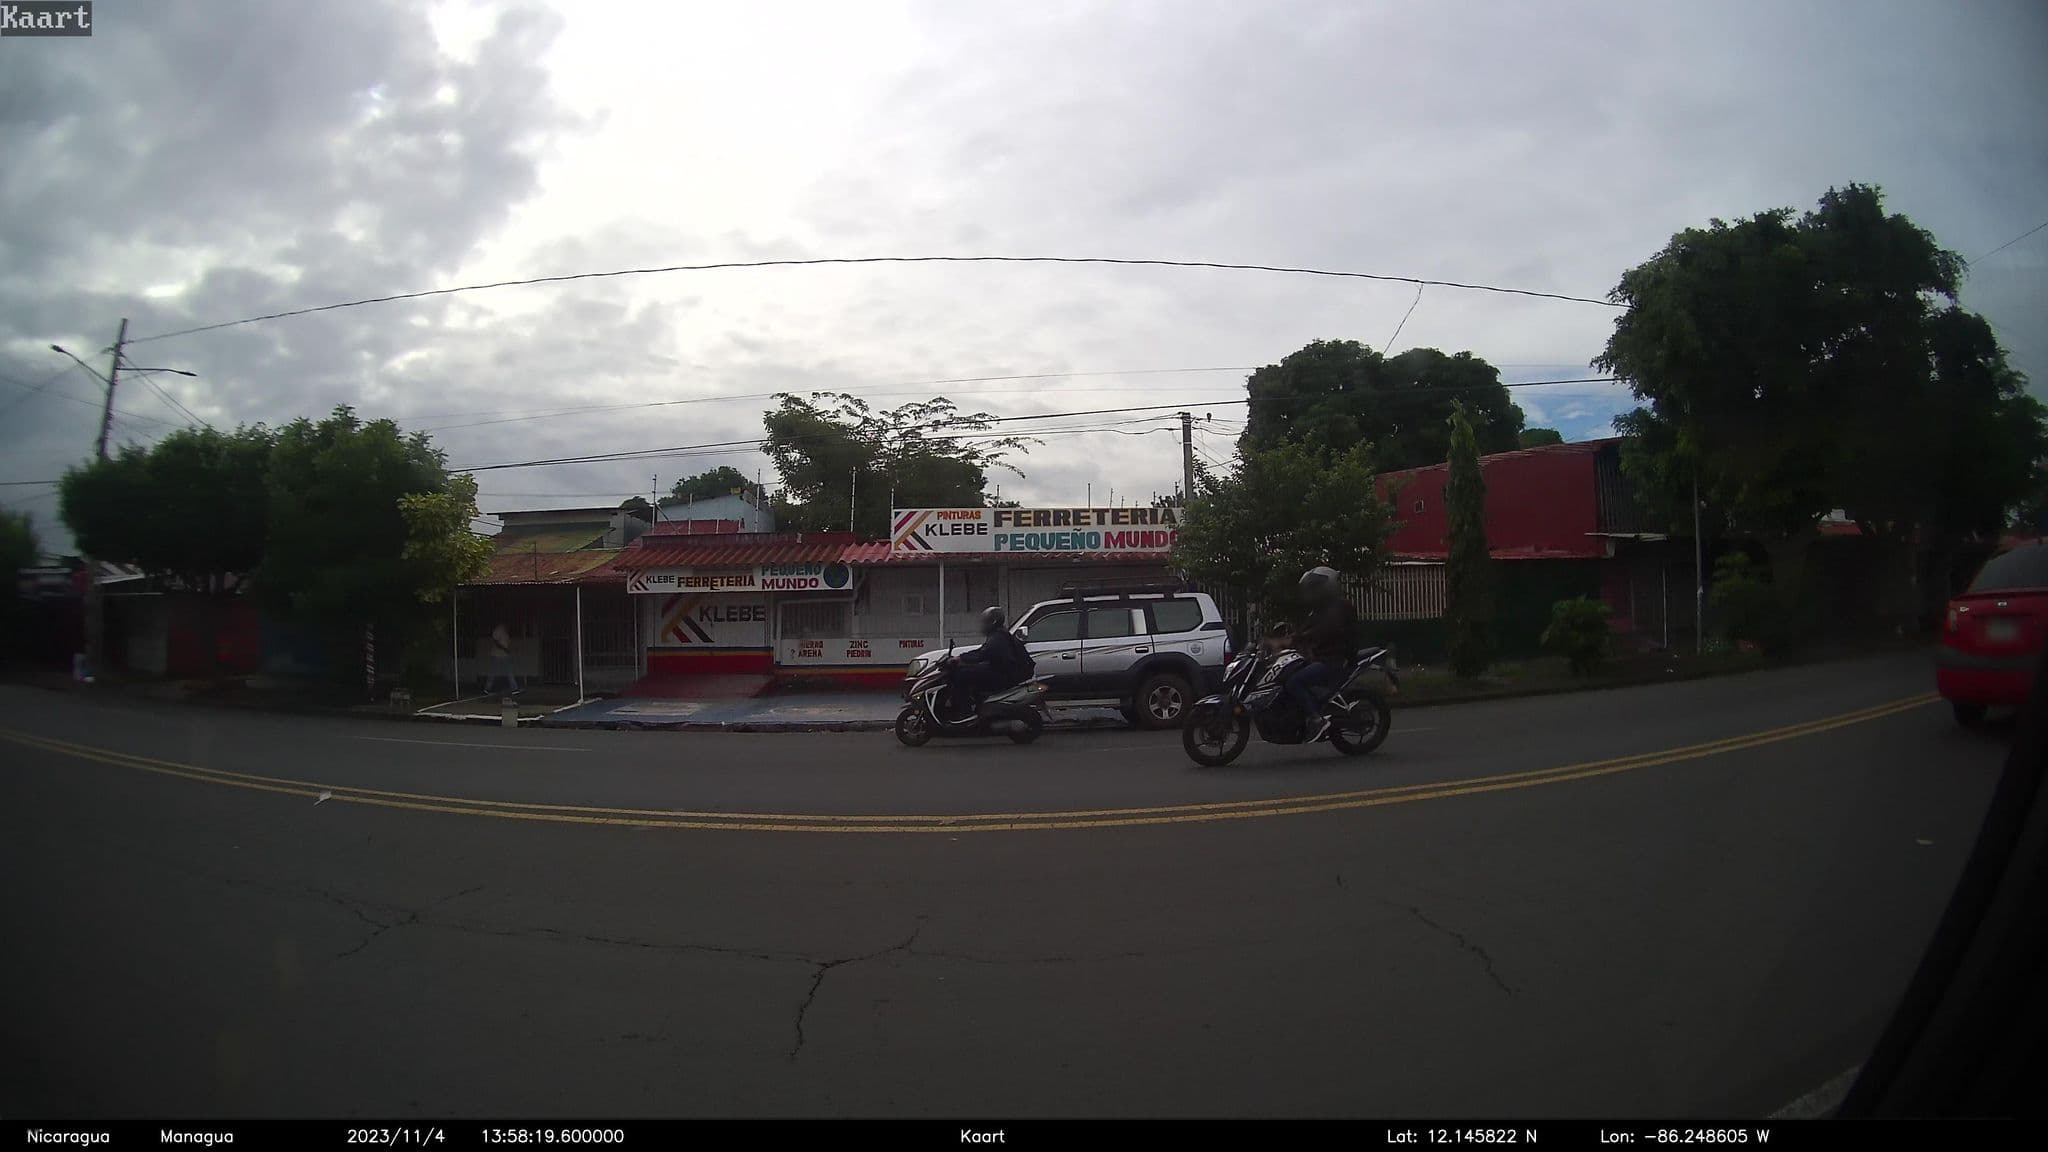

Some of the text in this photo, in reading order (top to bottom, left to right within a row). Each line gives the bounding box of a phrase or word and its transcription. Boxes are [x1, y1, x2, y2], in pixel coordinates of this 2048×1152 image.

[937, 510, 982, 521] PINTURAS
[994, 508, 1177, 528] FERRETERIA
[925, 522, 988, 537] KLEBE
[994, 528, 1100, 551] PEQUEÑO
[646, 575, 756, 591] KLEBE FERRETERIA
[761, 577, 819, 590] MUNDO
[699, 605, 766, 623] KLEBE
[849, 640, 869, 649] ZINC
